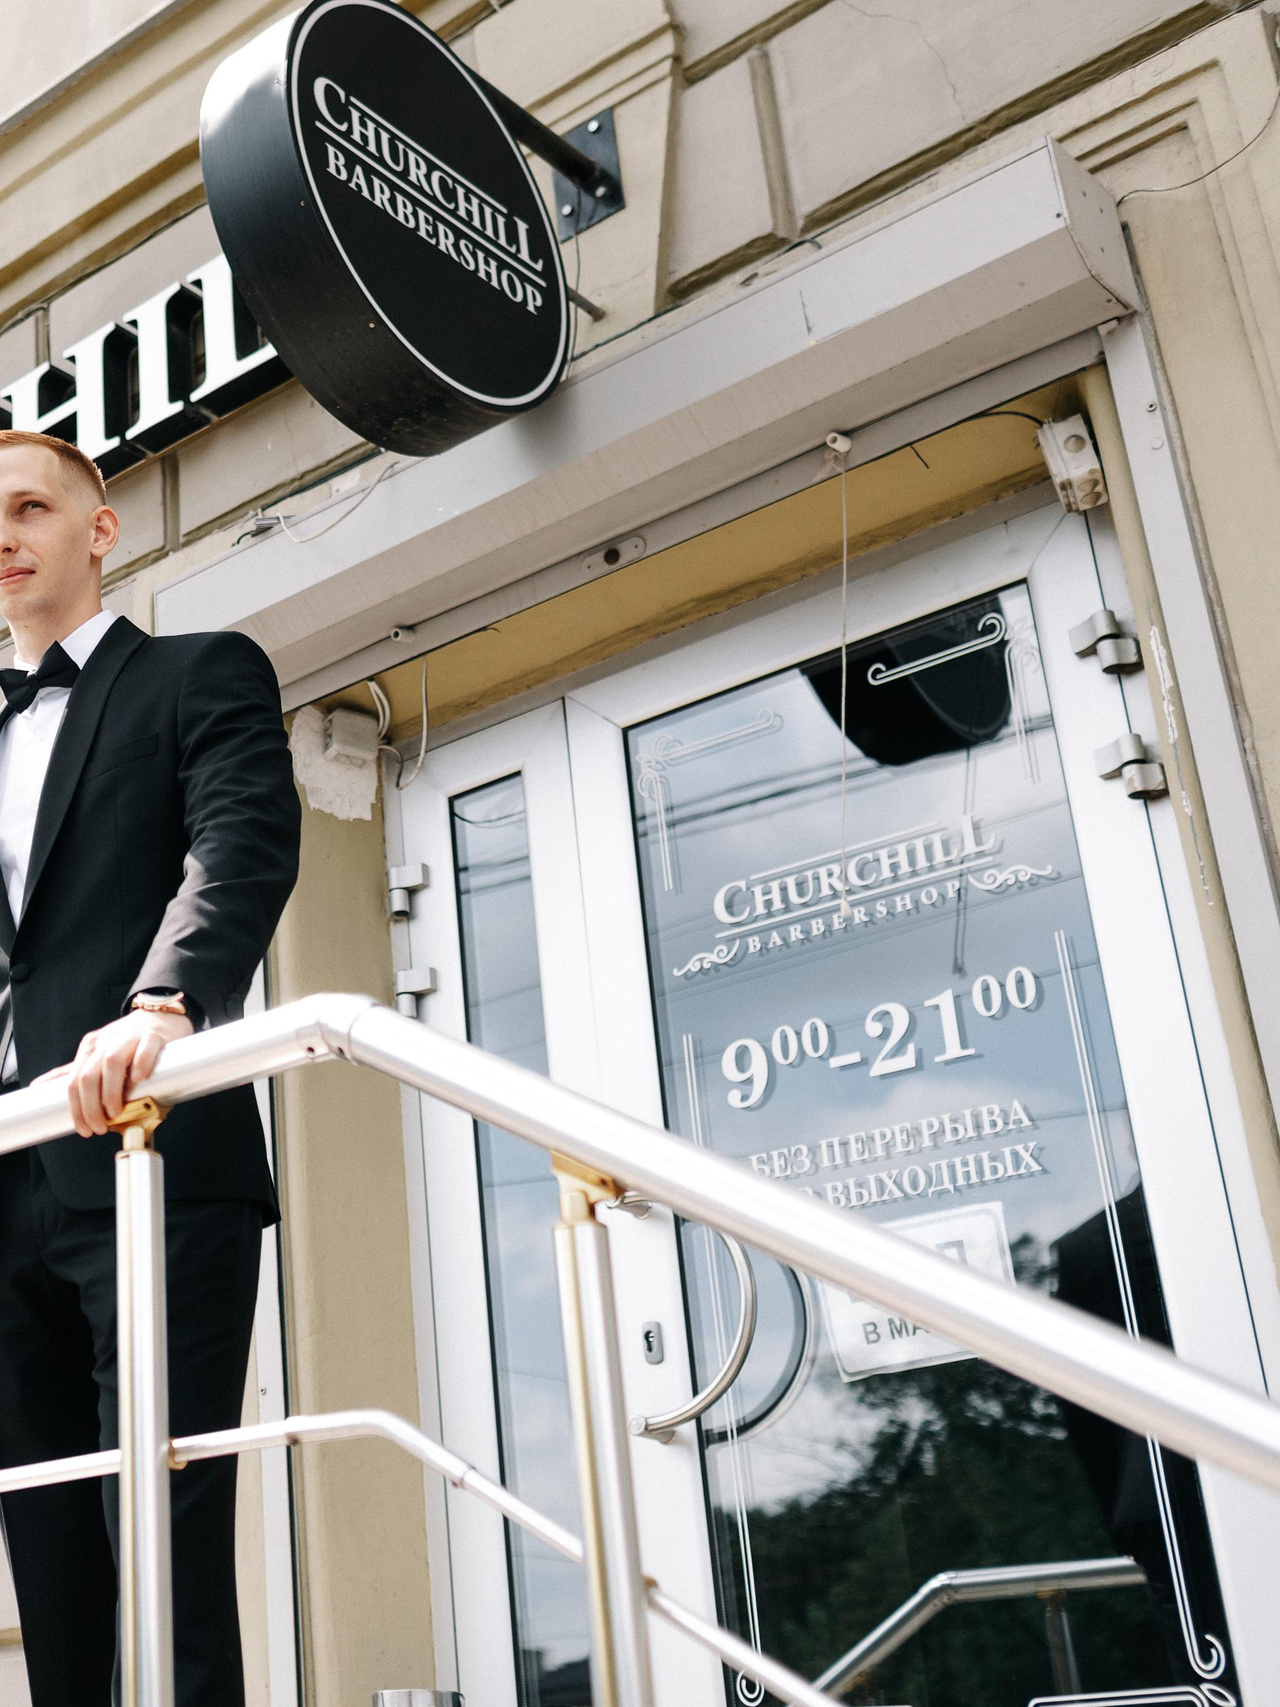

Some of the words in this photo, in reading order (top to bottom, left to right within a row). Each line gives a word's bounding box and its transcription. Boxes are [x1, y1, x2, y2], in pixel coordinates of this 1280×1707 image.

[313, 76, 544, 272] CHURCHILL
[324, 142, 543, 315] BARBERSHOP
[713, 812, 998, 925] CHURCHILL
[746, 880, 963, 955] BARBERSHOP
[748, 1143, 812, 1180] БЕЗ
[819, 1098, 1033, 1168] ПЕРЕРЫВА
[824, 1141, 1043, 1209] ВЫХОДНЫХ
